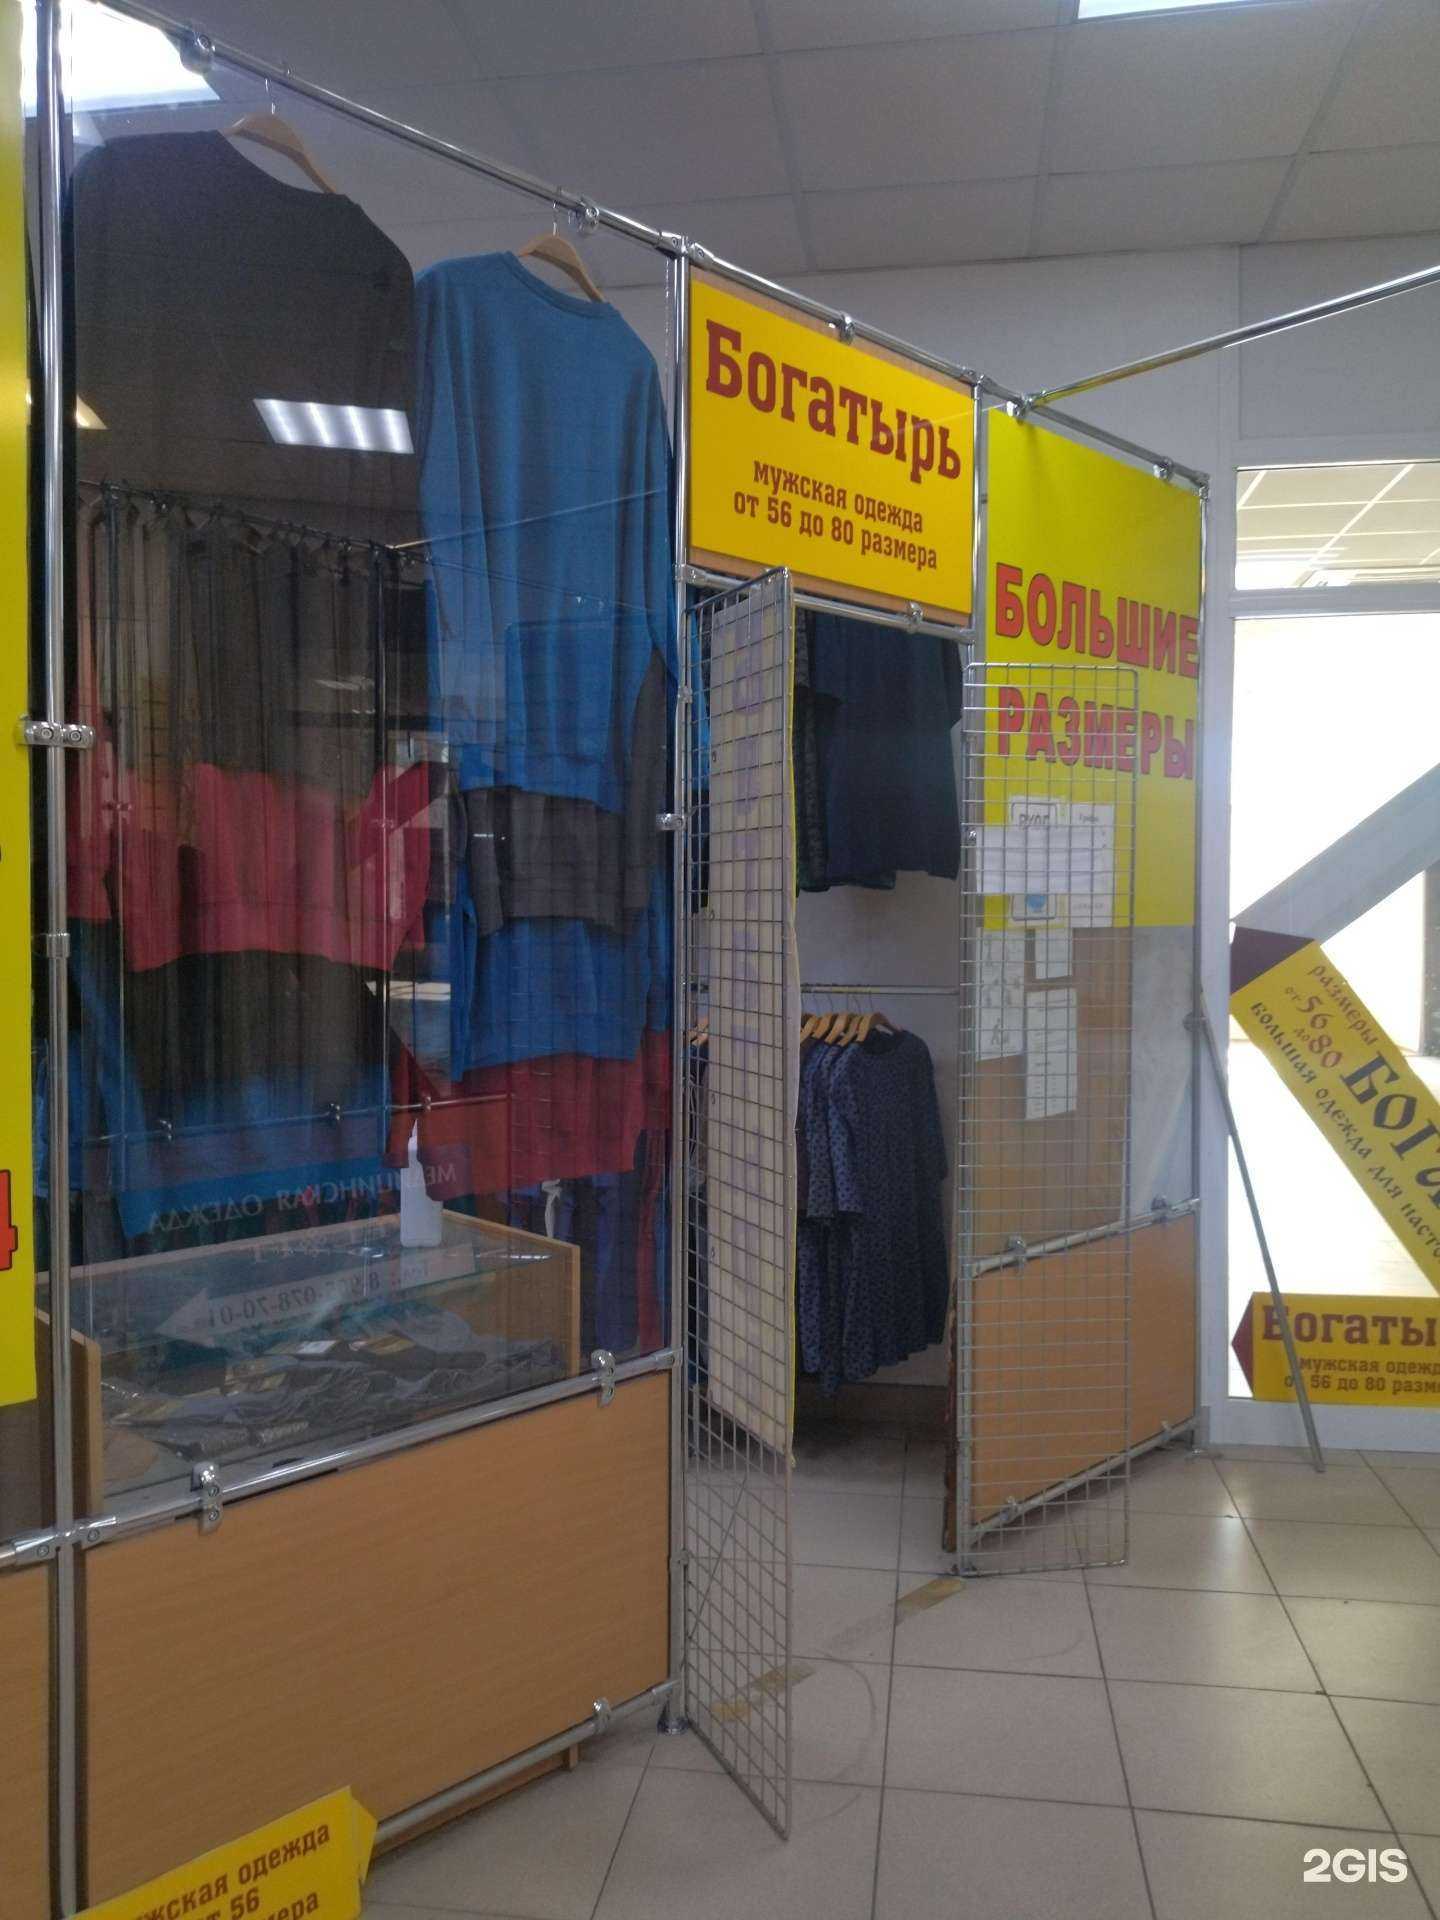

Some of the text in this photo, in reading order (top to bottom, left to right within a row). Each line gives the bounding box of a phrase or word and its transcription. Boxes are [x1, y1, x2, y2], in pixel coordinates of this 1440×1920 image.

[706, 319, 961, 484] Богатырь
[734, 491, 937, 571] от 56 до 80 размера
[753, 460, 923, 533] мужская одежда
[996, 562, 1200, 679] БОЛЬШИЕ
[997, 686, 1194, 780] РАЗМЕРЫ
[1285, 986, 1335, 1029] от 56
[1307, 966, 1378, 1046] размеры
[1293, 1028, 1343, 1068] до 80
[1368, 1165, 1403, 1199] для
[1299, 1358, 1379, 1374] мужская
[1311, 1374, 1330, 1389] 56
[1337, 1377, 1358, 1391] до
[1364, 1377, 1385, 1391] 80
[1392, 1380, 1440, 1396] разм
[133, 1823, 330, 1920] жская одежда
[231, 1887, 259, 1920] 56
